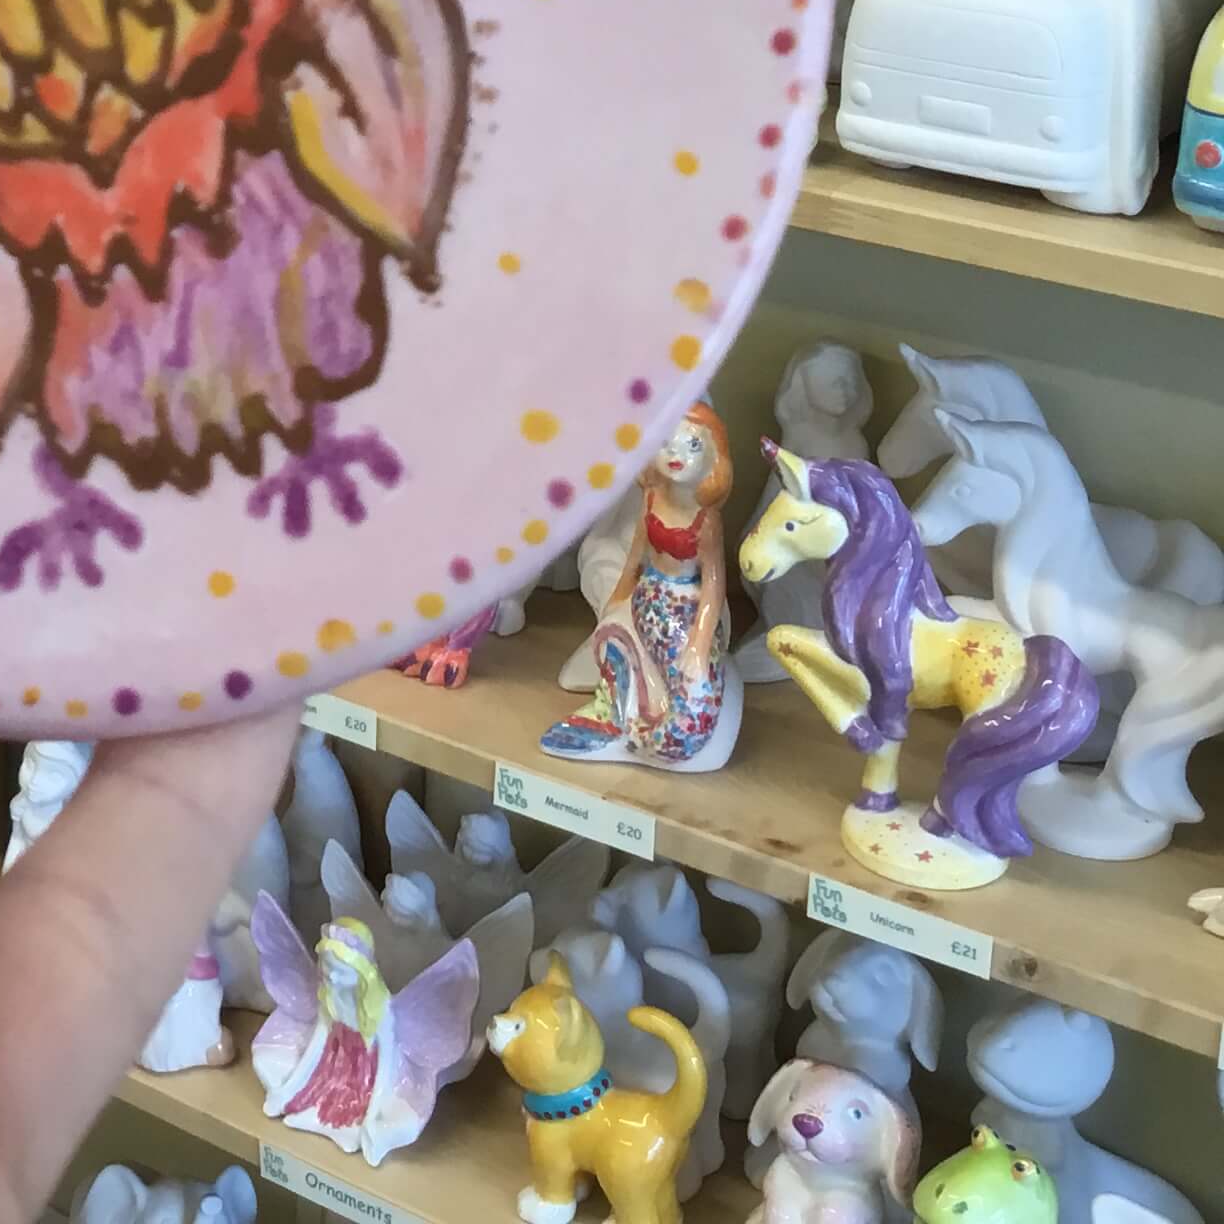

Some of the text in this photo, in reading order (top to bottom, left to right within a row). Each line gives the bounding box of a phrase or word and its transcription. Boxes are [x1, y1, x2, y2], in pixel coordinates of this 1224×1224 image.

[345, 716, 367, 733] £20
[499, 768, 524, 790] Fun
[498, 781, 528, 809] Pots
[545, 795, 589, 820] Mermaid
[616, 822, 643, 841] £20
[815, 878, 843, 903] Fun
[813, 893, 848, 924] Pots
[870, 911, 915, 936] Unicorn
[950, 940, 977, 960] £21
[305, 1172, 393, 1224] Ornaments
